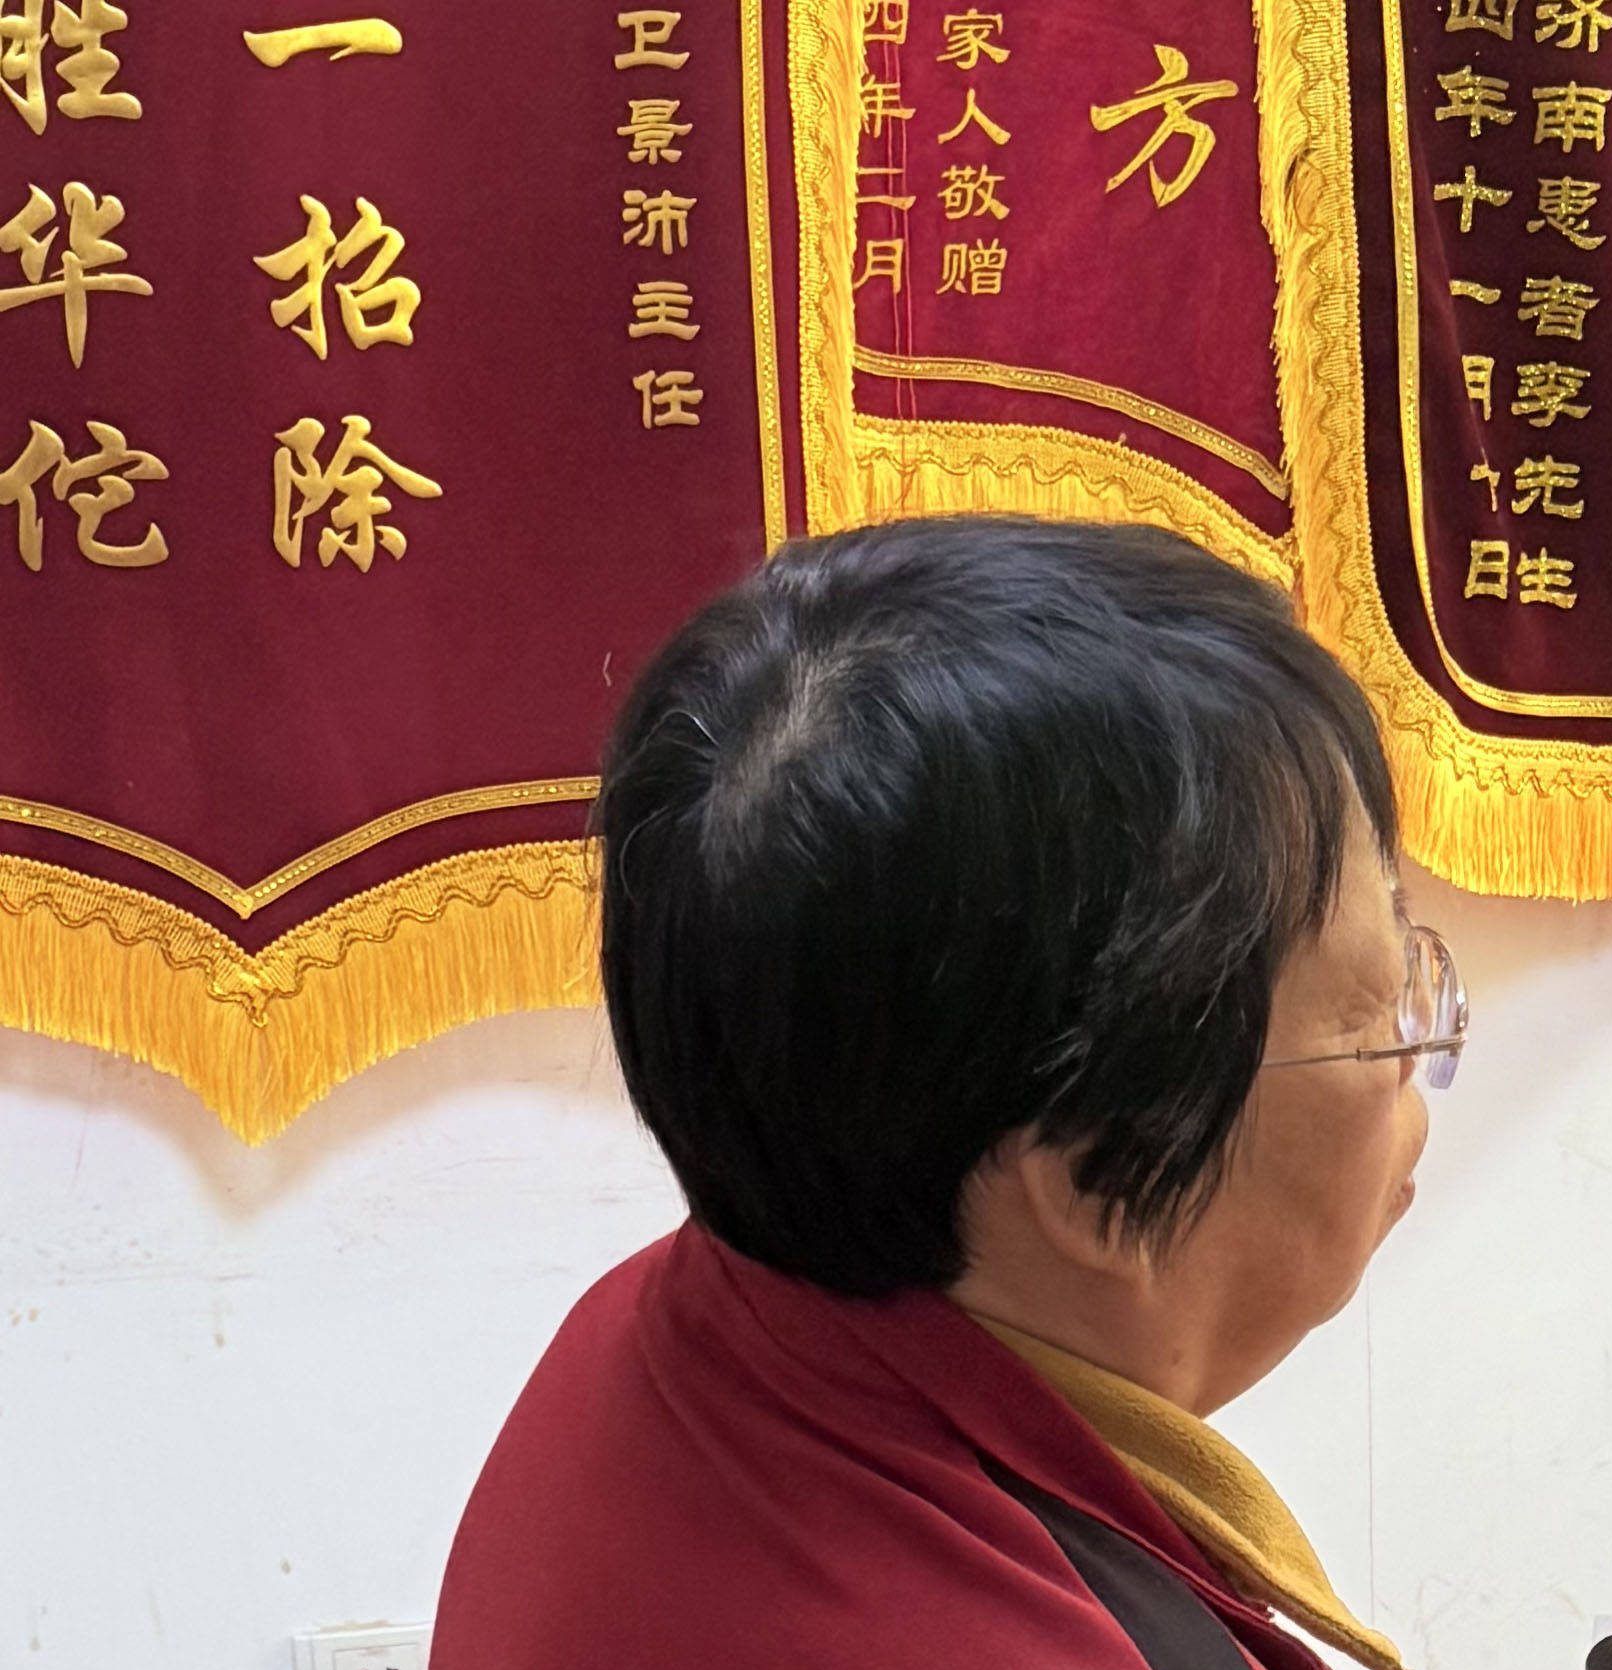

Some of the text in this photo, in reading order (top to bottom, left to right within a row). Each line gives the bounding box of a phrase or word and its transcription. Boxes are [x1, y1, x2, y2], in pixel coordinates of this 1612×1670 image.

[0, 0, 169, 572] 胜华佗
[243, 18, 443, 573] 一招除
[614, 9, 704, 429] 卫景沛主任
[936, 8, 1010, 296] 家人敬赠
[1090, 44, 1238, 208] 方
